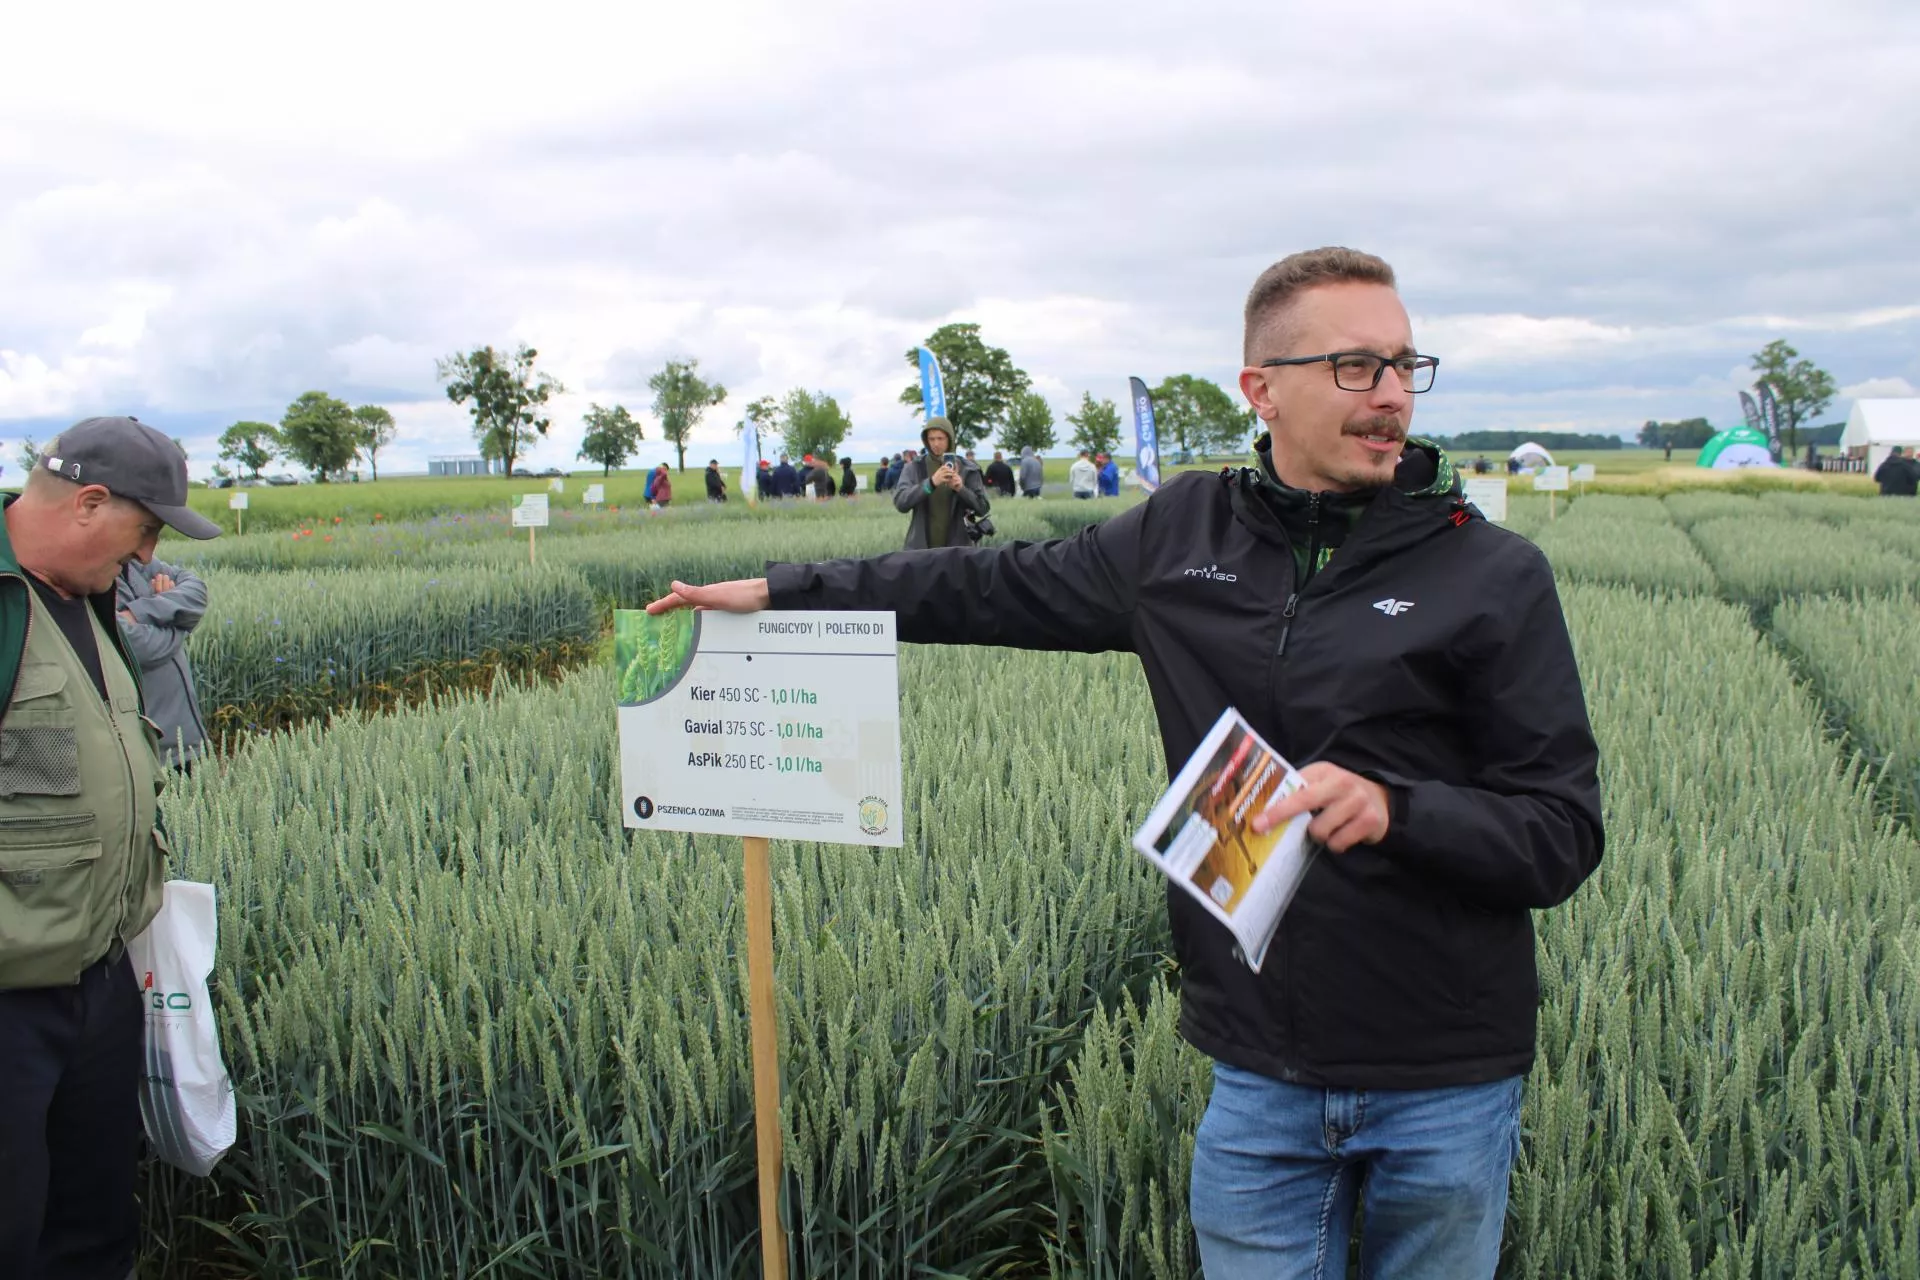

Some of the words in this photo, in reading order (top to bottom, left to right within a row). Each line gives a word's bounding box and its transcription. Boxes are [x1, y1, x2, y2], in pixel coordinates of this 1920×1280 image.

[1373, 598, 1415, 616] 4F
[758, 622, 814, 635] FUNGICYDY
[825, 622, 870, 635] POLETKO
[873, 623, 884, 635] D1
[690, 686, 716, 701] Kier
[719, 687, 741, 702] 450
[744, 687, 760, 703] SC
[771, 688, 787, 705] 1,0
[684, 718, 723, 735] Gavial
[726, 720, 747, 736] 375
[750, 721, 766, 737] SC
[776, 722, 793, 739] 1,0
[687, 751, 722, 768] AsPik
[724, 753, 746, 769] 250
[750, 754, 765, 770] EC
[776, 756, 793, 773] 1,0
[657, 805, 697, 815] PSZENICA
[698, 808, 726, 818] OZIMA
